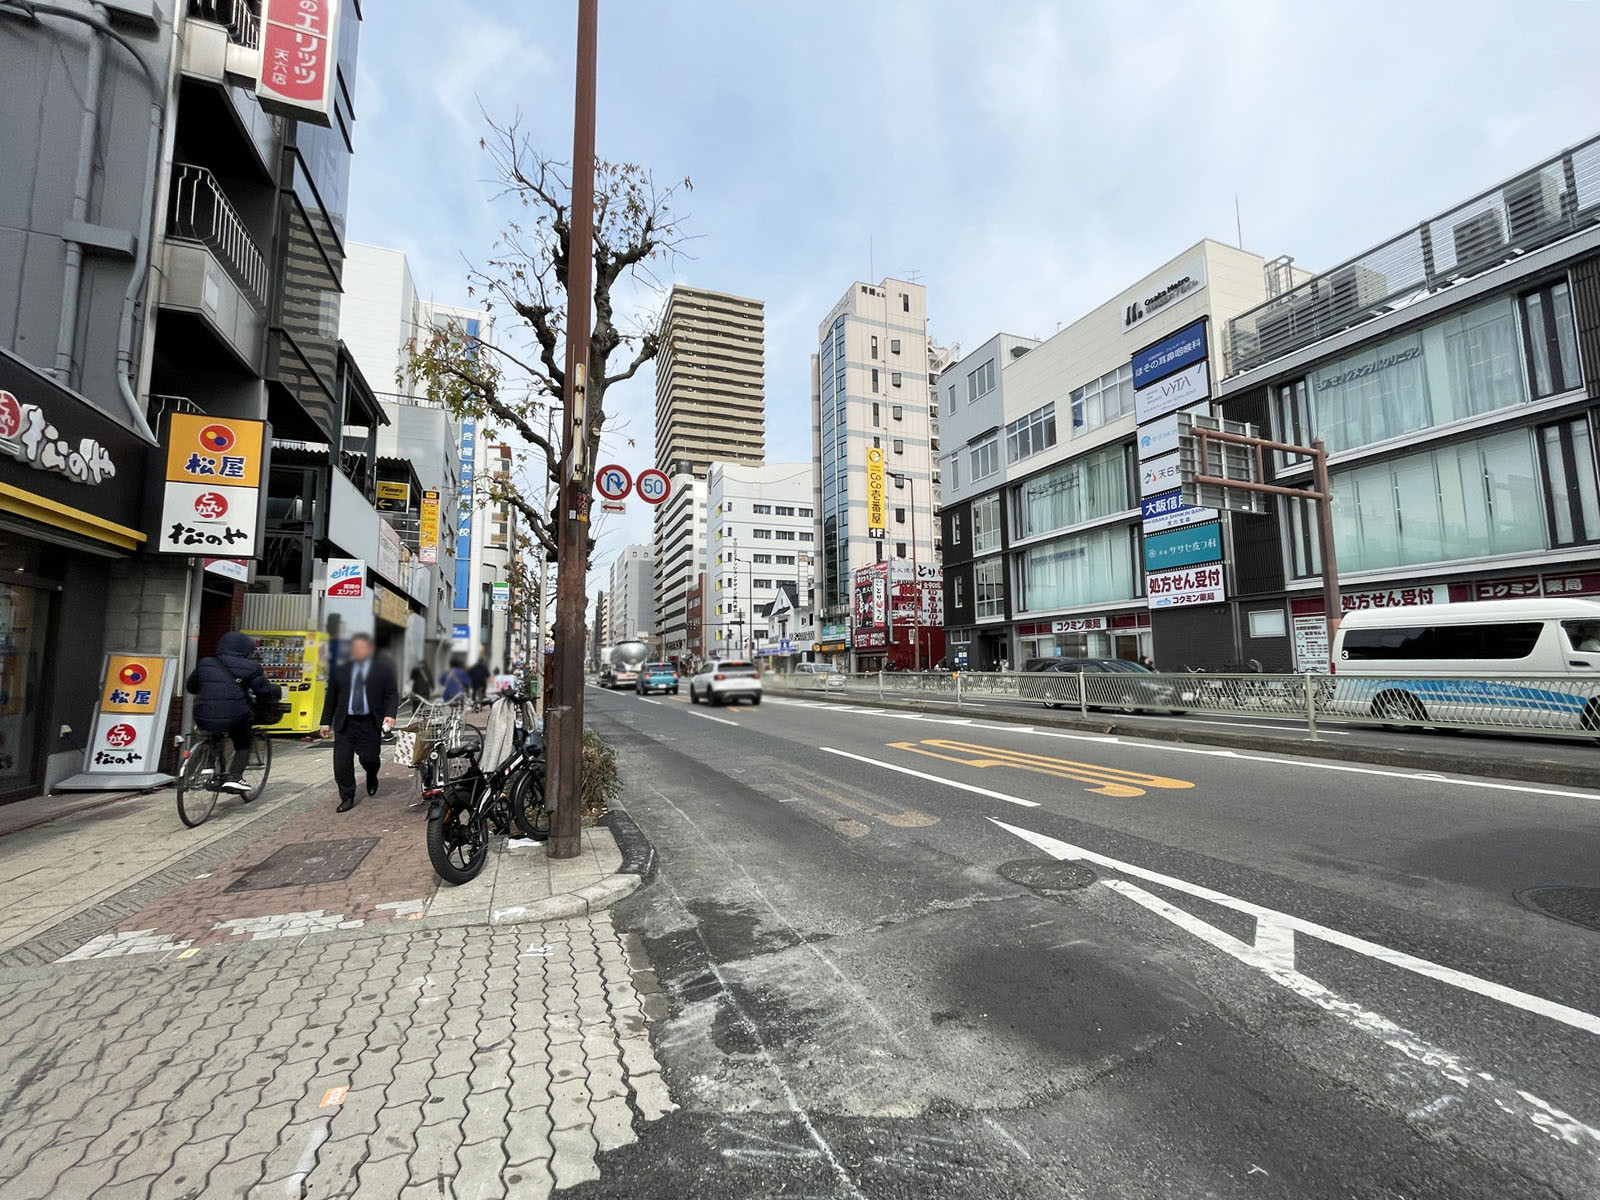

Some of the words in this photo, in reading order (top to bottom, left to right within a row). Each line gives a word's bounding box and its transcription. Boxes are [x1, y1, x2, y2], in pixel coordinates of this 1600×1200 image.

[272, 48, 290, 85] 天六店
[185, 452, 245, 478] 松屋
[644, 479, 663, 494] 50
[870, 529, 885, 537] 1F
[1149, 568, 1220, 594] 処方せん受付
[1480, 578, 1583, 597] コクミン薬局
[1172, 592, 1214, 604] コクミン薬局
[1341, 588, 1434, 610] 処方せん受付
[1056, 619, 1101, 631] コクミン薬局
[1341, 650, 1349, 659] 3
[110, 689, 151, 704] 松屋
